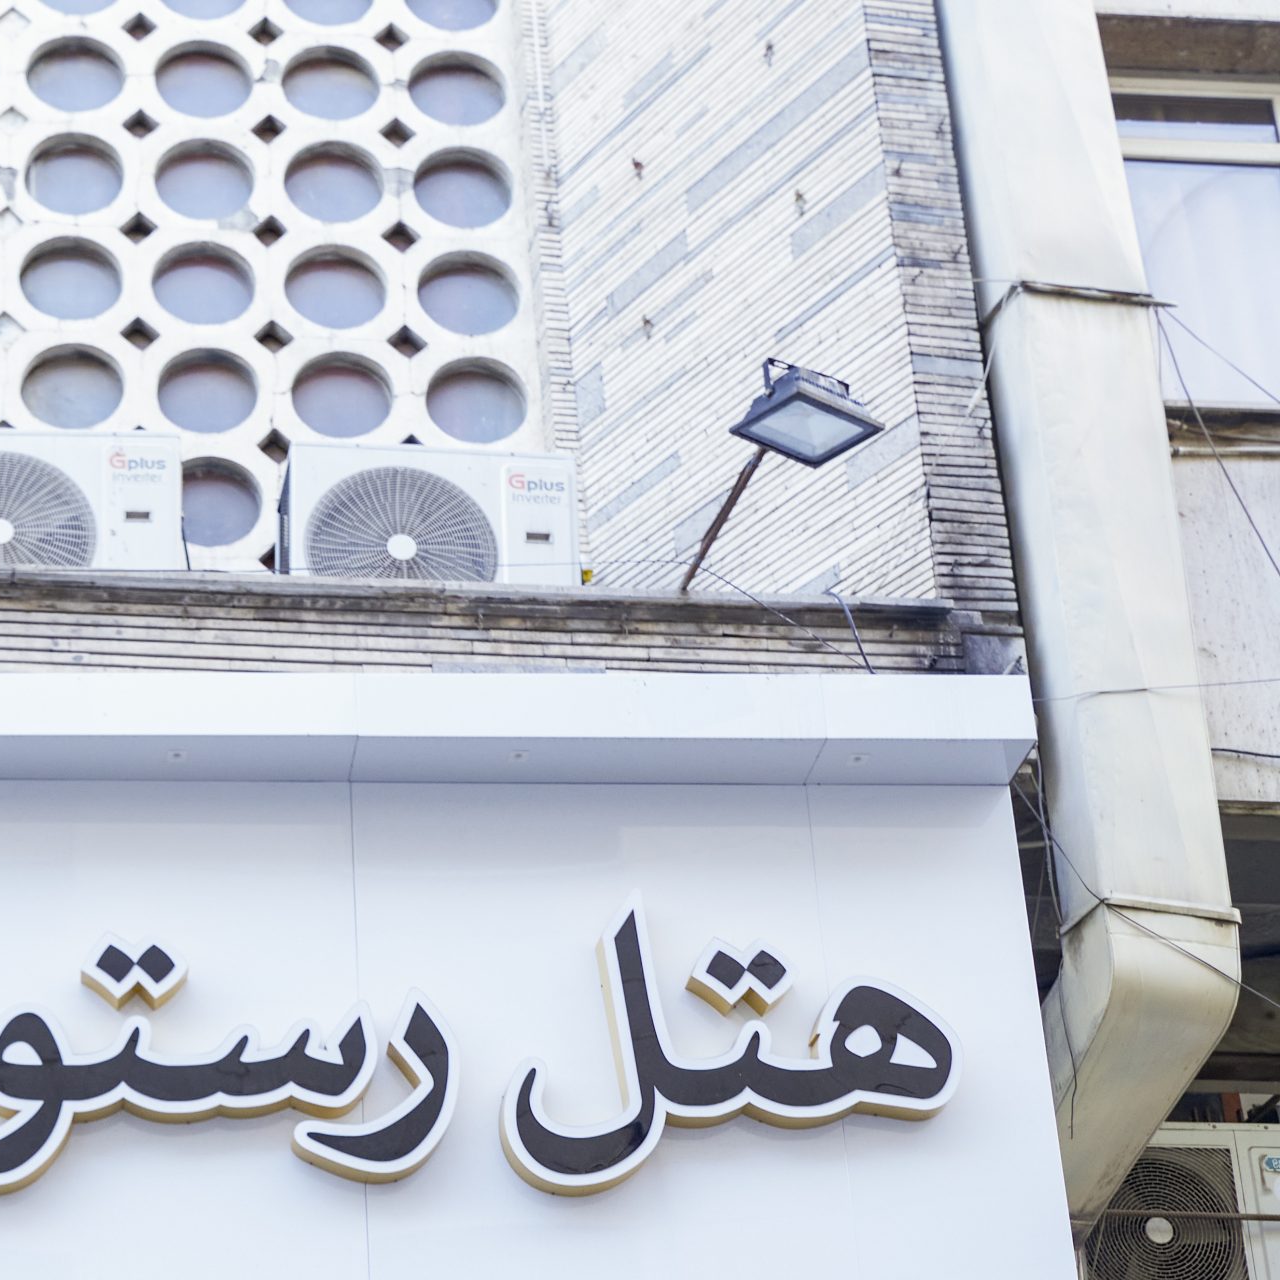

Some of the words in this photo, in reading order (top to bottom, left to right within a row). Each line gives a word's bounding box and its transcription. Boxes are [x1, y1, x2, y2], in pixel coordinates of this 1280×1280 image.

[109, 452, 166, 471] Gplus
[508, 474, 565, 492] Gplus
[500, 890, 963, 1196] هتل
